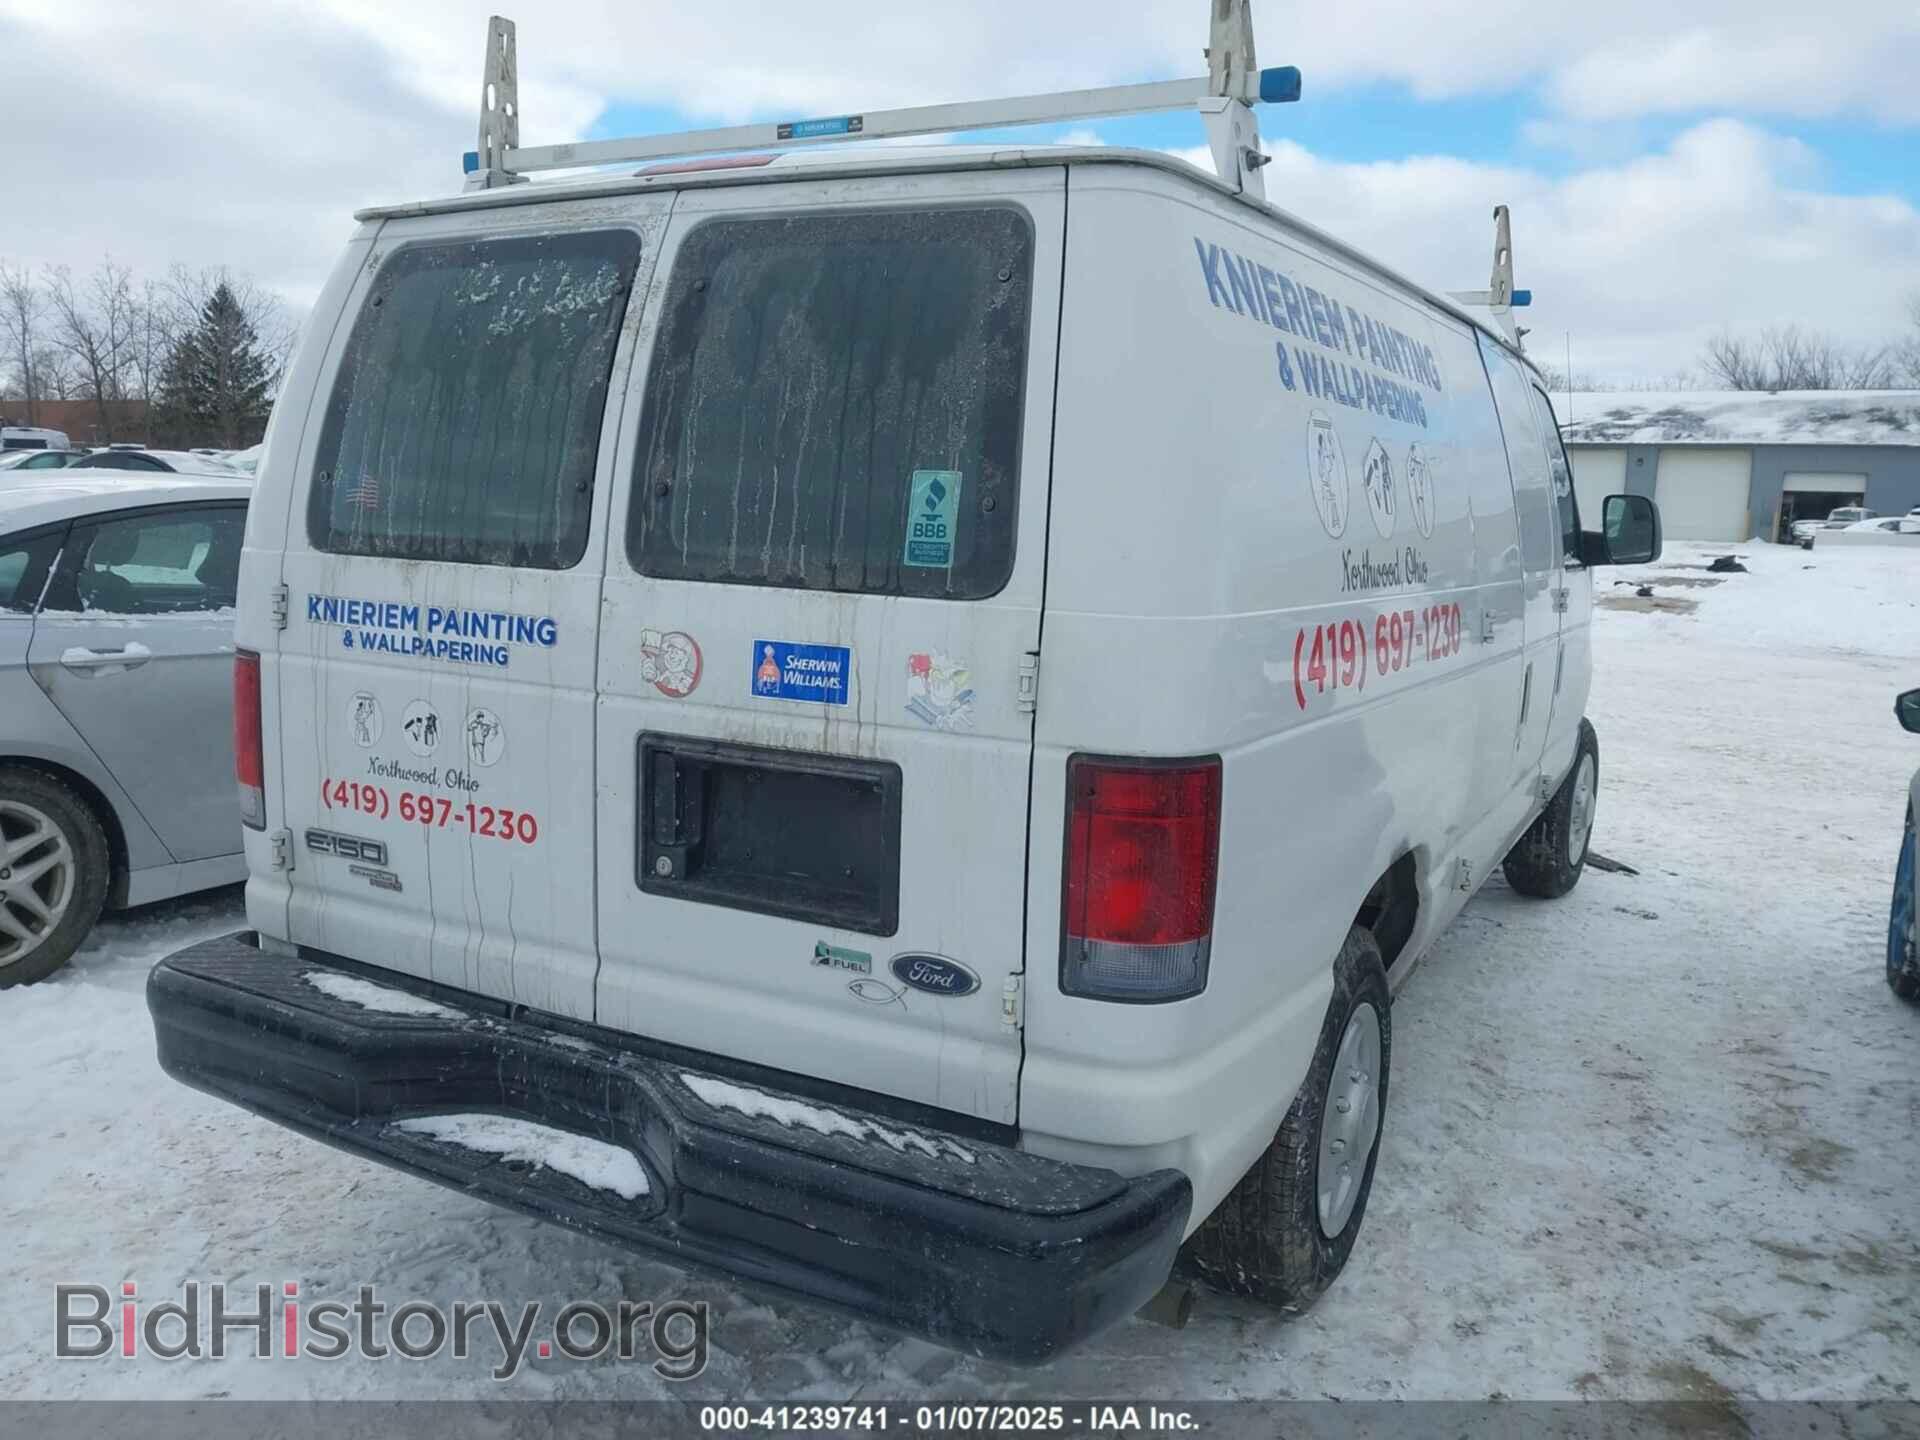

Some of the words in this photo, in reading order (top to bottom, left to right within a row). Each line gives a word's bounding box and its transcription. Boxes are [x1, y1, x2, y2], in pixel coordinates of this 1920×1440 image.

[1193, 236, 1353, 356] KNIERIEM
[1345, 304, 1442, 393] PAINTING
[1276, 340, 1297, 393] &
[1294, 345, 1428, 430] WALLPAPERING
[912, 522, 947, 539] BBB
[1405, 546, 1428, 585] Ohio
[307, 594, 420, 631] KNIERIEM
[427, 607, 558, 646] PAINTING
[342, 629, 354, 648] &
[359, 631, 510, 667] WALLPAPERING
[785, 655, 841, 673] SHERWIN
[1293, 619, 1368, 711] (419)
[1374, 601, 1462, 676] 697-1230
[444, 767, 481, 793] Ohio
[321, 778, 390, 820] (419)
[399, 791, 539, 844] 697-1230
[833, 959, 866, 973] FUEL
[908, 959, 955, 989] Ford
